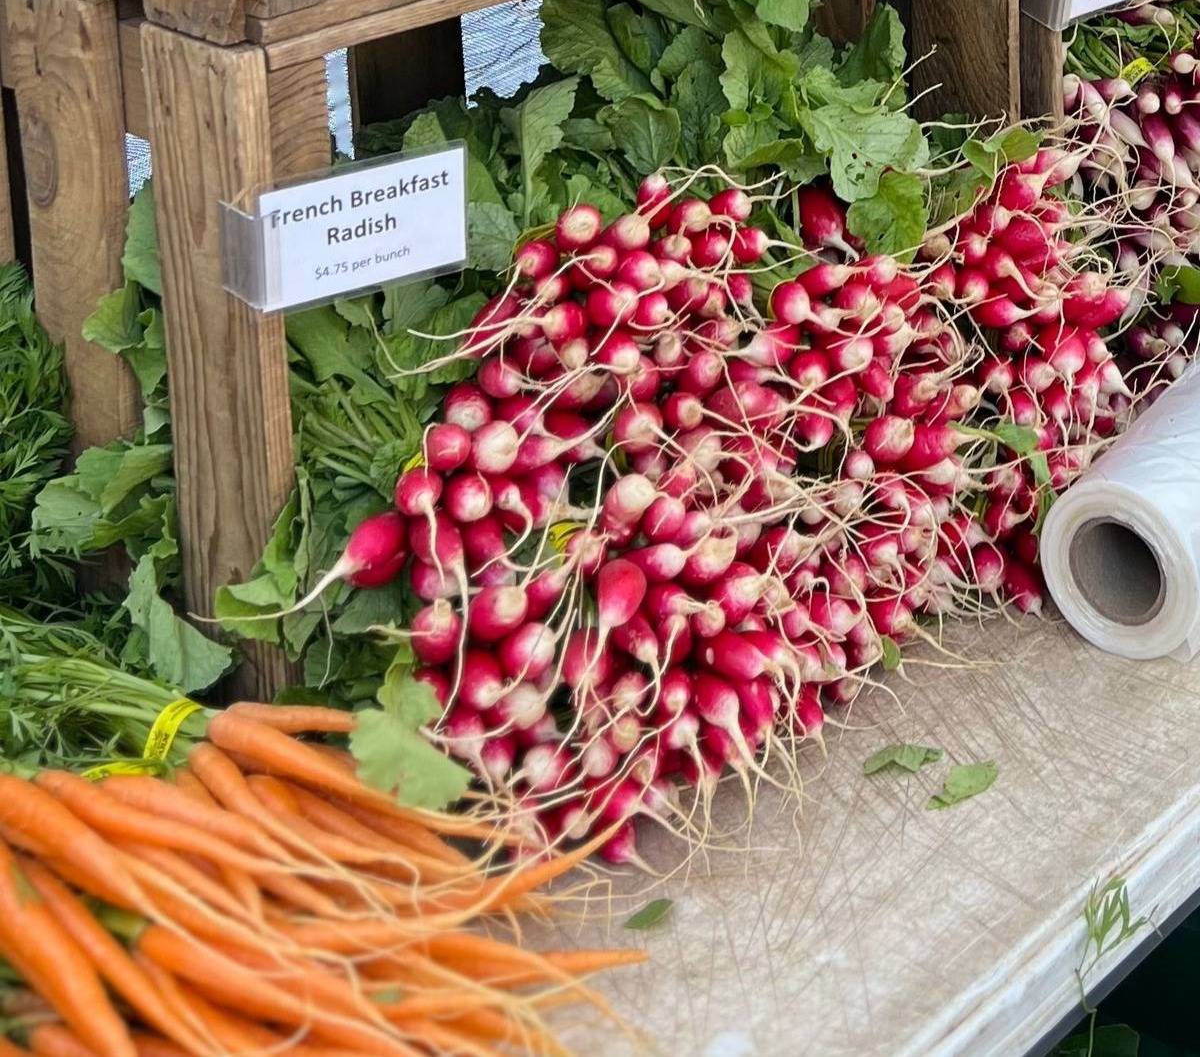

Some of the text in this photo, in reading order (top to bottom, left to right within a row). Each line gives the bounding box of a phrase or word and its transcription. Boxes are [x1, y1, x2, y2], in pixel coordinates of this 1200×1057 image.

[270, 169, 449, 229] French Breakfast
[326, 213, 397, 246] Radish
[314, 245, 411, 281] $4.75 per bunch
